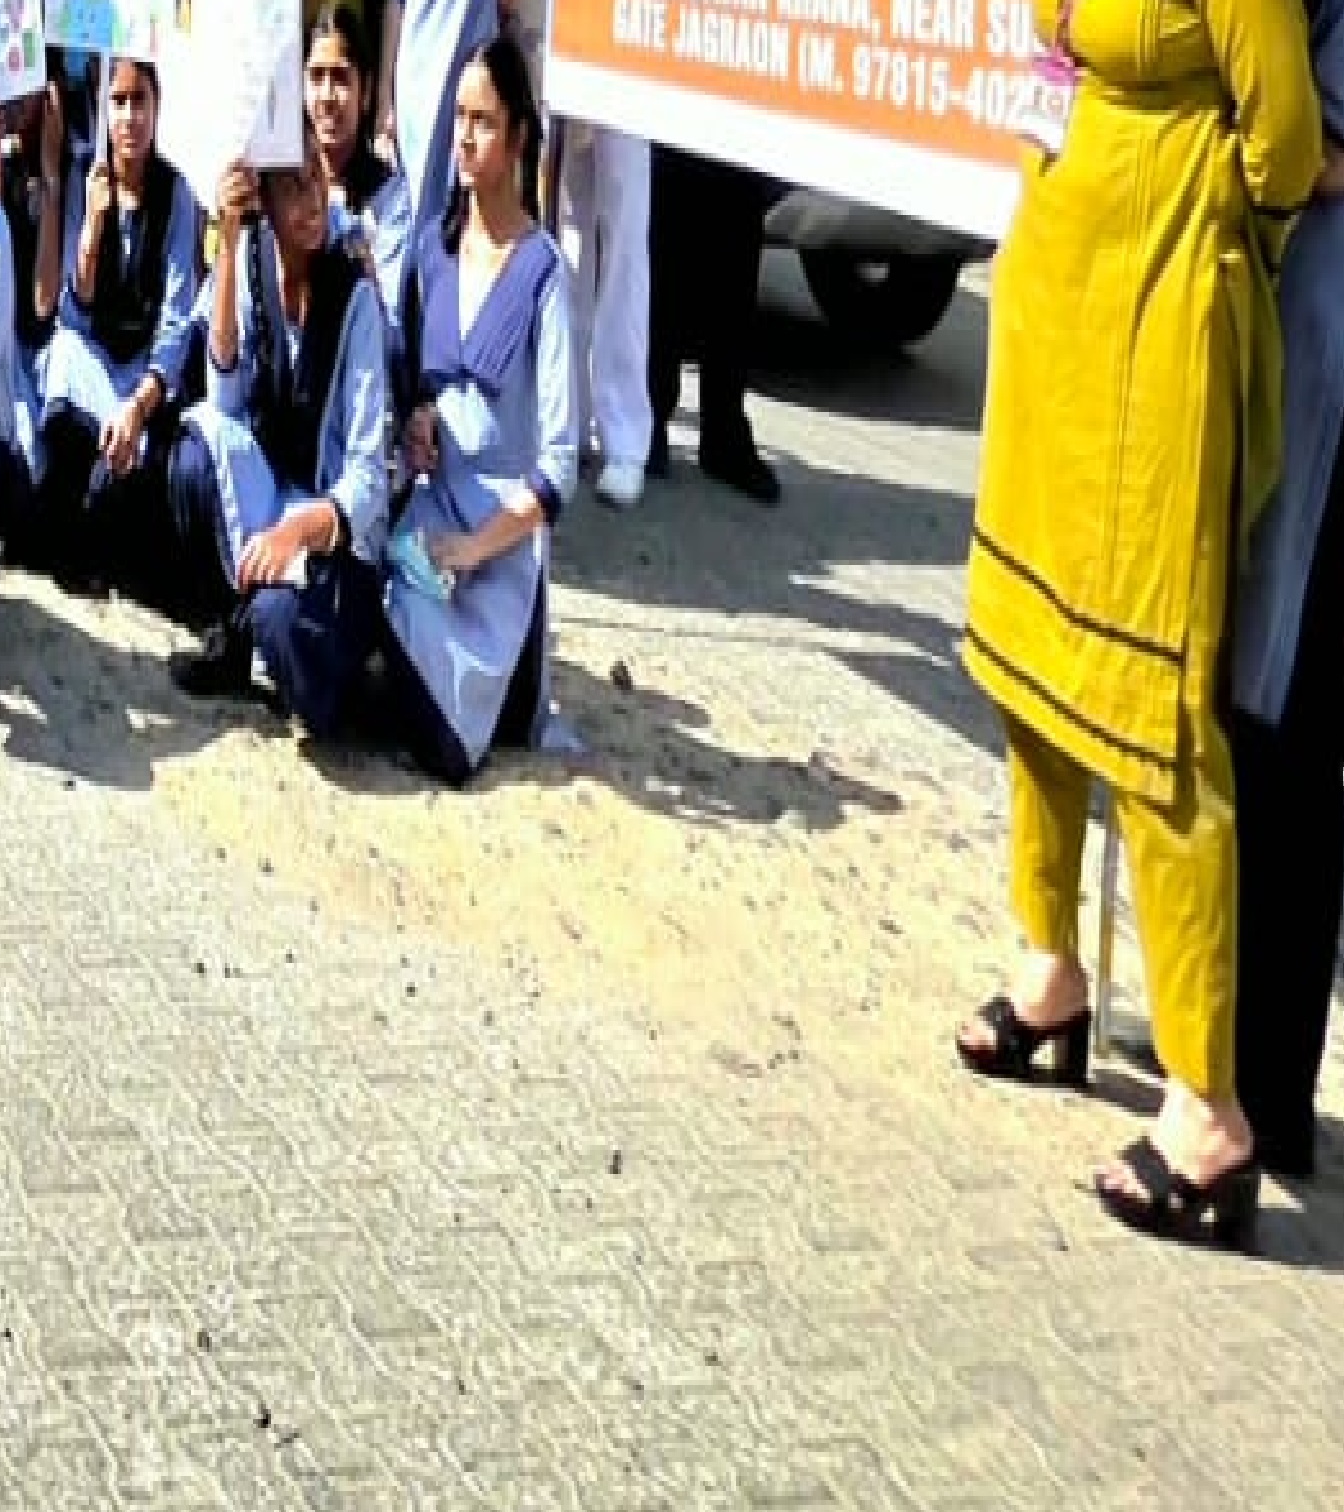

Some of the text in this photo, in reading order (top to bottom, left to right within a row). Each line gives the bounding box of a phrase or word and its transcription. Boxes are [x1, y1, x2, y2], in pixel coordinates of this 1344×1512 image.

[672, 3, 790, 81] JAGRAON
[797, 22, 844, 94] (M.
[851, 45, 1034, 125] 97815-402
